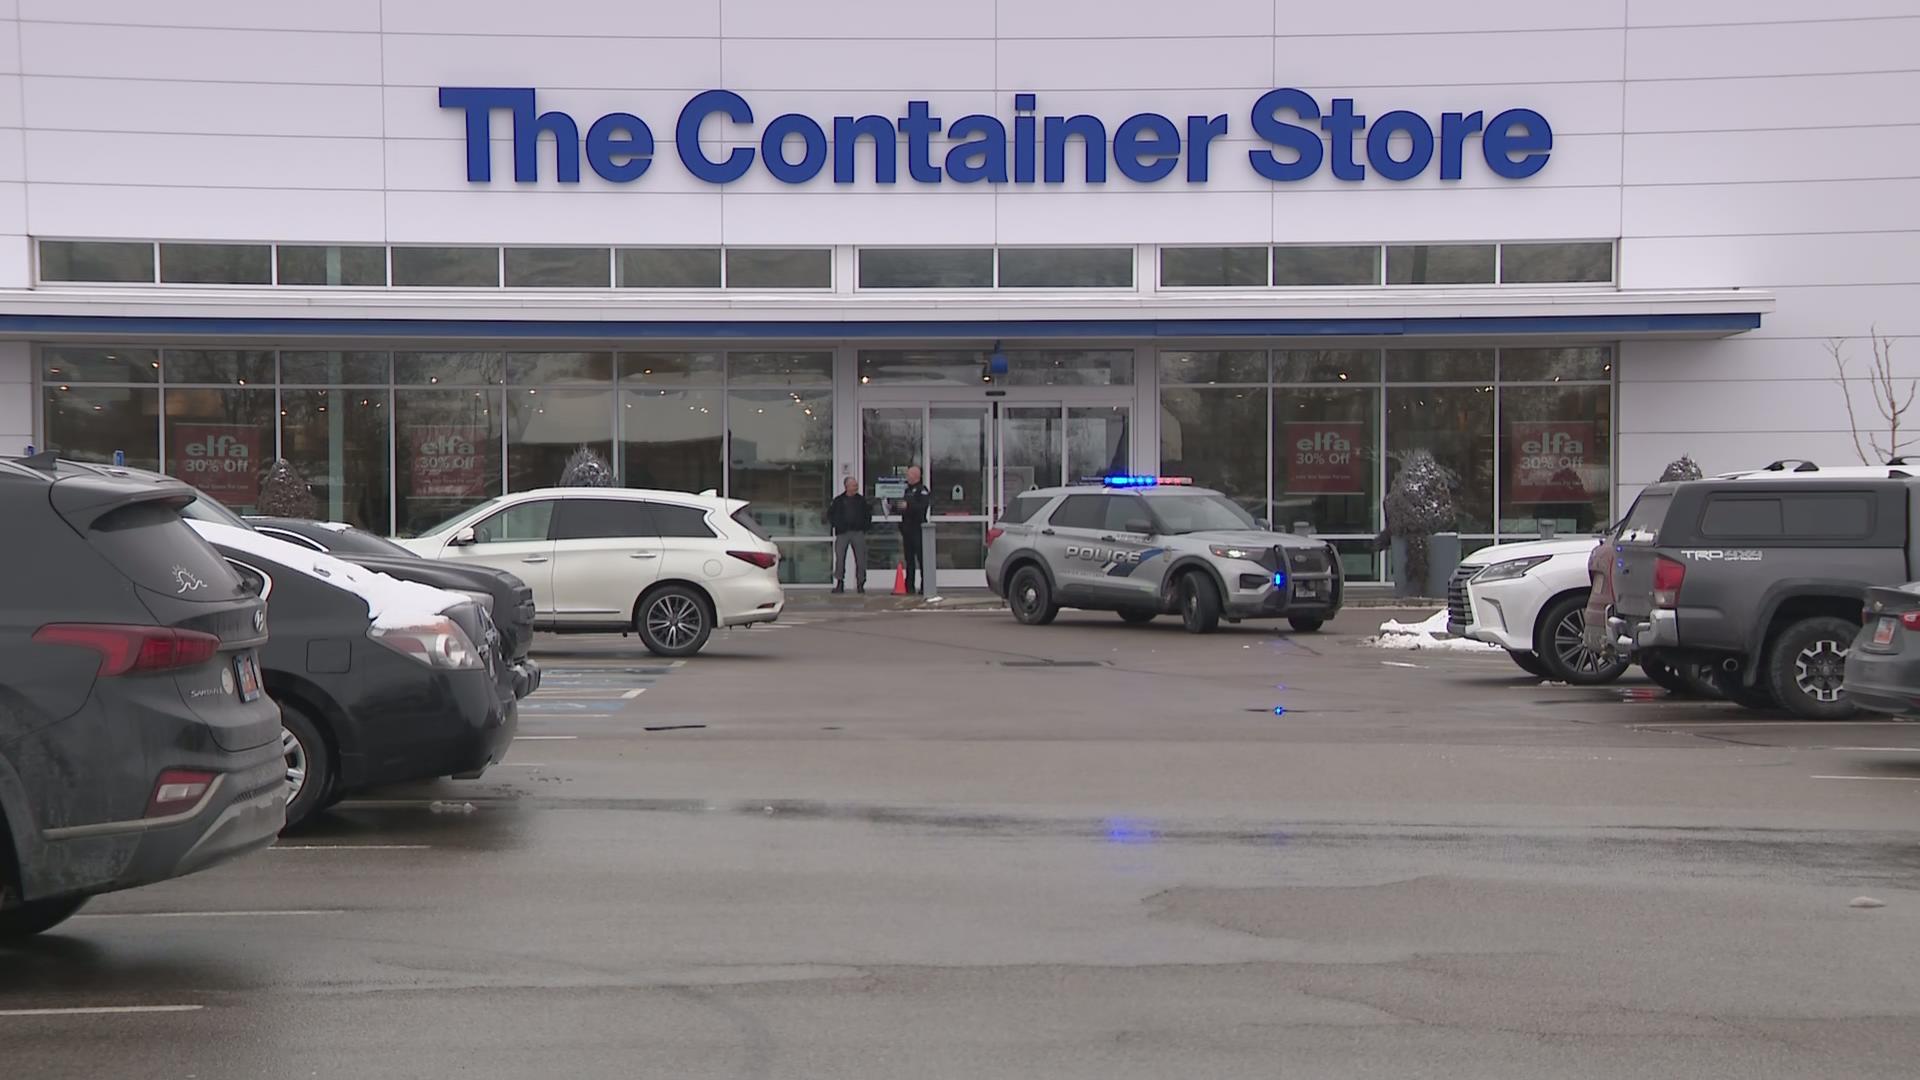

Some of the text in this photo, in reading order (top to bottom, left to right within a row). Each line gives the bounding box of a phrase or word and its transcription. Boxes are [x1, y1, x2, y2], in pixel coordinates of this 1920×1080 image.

[438, 87, 1553, 184] The Container Store
[185, 435, 248, 457] elfa
[421, 435, 475, 455] elfa
[1296, 431, 1351, 451] elfa
[1521, 432, 1584, 454] elfa
[185, 459, 248, 472] 30% Off
[454, 456, 475, 470] Off
[1296, 452, 1350, 465] 30% Off
[1521, 456, 1584, 470] 30% Off
[1064, 545, 1142, 564] POLICE
